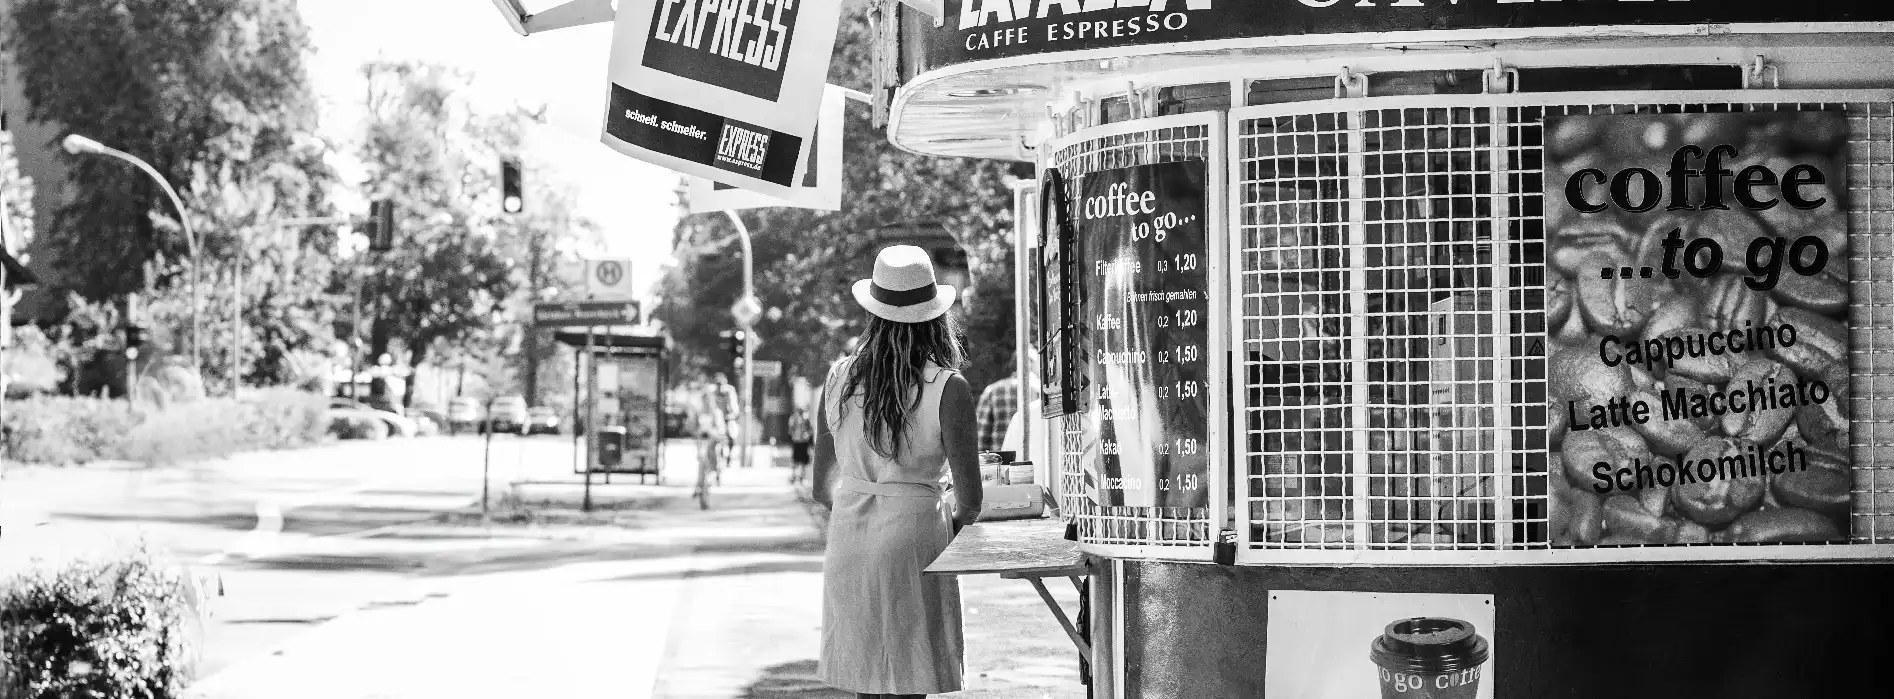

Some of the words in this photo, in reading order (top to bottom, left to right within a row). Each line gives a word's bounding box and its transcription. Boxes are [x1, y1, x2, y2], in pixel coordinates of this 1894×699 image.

[965, 26, 1028, 51] CAFFE
[1047, 12, 1188, 42] ESPRESSO
[625, 109, 659, 127] schnell.
[660, 120, 707, 141] schneller.
[718, 124, 769, 165] EXPRESS
[1564, 143, 1828, 215] coffee
[1085, 181, 1156, 220] coffee
[1131, 222, 1150, 242] to
[1153, 211, 1196, 243] go...
[1157, 260, 1168, 273] 0,3
[1174, 253, 1197, 274] 1,20
[1600, 226, 1724, 280] ...to
[1743, 233, 1829, 292] go
[1148, 289, 1165, 302] frisch
[1165, 288, 1197, 304] gemahlen
[1096, 313, 1121, 330] Kaffee
[1157, 315, 1169, 328] 0,2
[1175, 309, 1198, 329] 1,20
[1158, 350, 1169, 364] 0,2
[1175, 344, 1198, 365] 1,50
[1599, 319, 1798, 372] Cappuccino
[1158, 386, 1169, 399] 0,2
[1175, 380, 1198, 400] 1,50
[1567, 396, 1651, 432] Latte
[1660, 375, 1830, 422] Macchiato
[1099, 438, 1122, 455] Kakao
[1175, 438, 1198, 457] 1,50
[1159, 478, 1170, 491] 0,2
[1176, 473, 1198, 492] 1,50
[1592, 441, 1807, 495] Schokomilch
[1394, 672, 1423, 692] go
